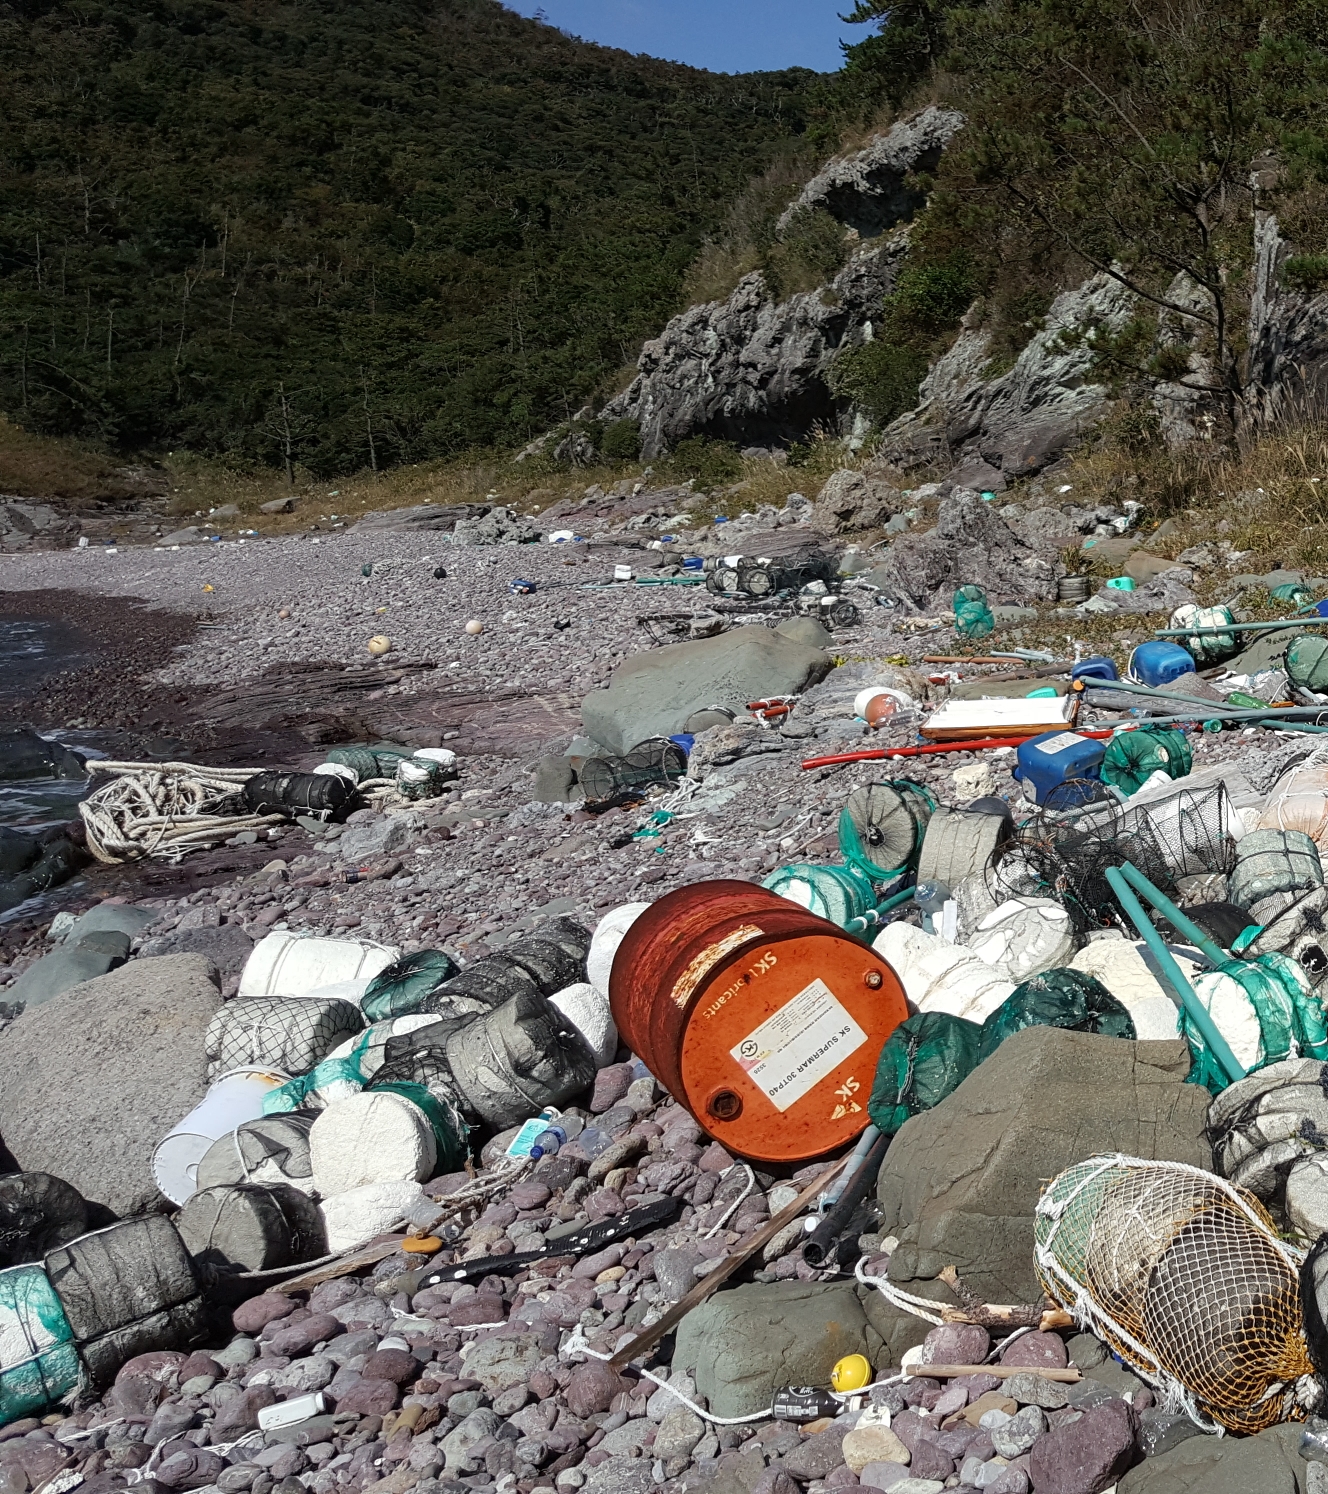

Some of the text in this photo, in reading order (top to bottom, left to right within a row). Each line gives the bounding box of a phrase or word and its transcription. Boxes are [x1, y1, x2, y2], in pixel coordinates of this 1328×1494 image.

[754, 951, 777, 975] SK
[703, 968, 756, 1020] lbricants
[838, 1025, 851, 1037] SK
[797, 1035, 838, 1072] SUPERMAR
[769, 1071, 797, 1096] 30TP40
[835, 1076, 860, 1102] SK
